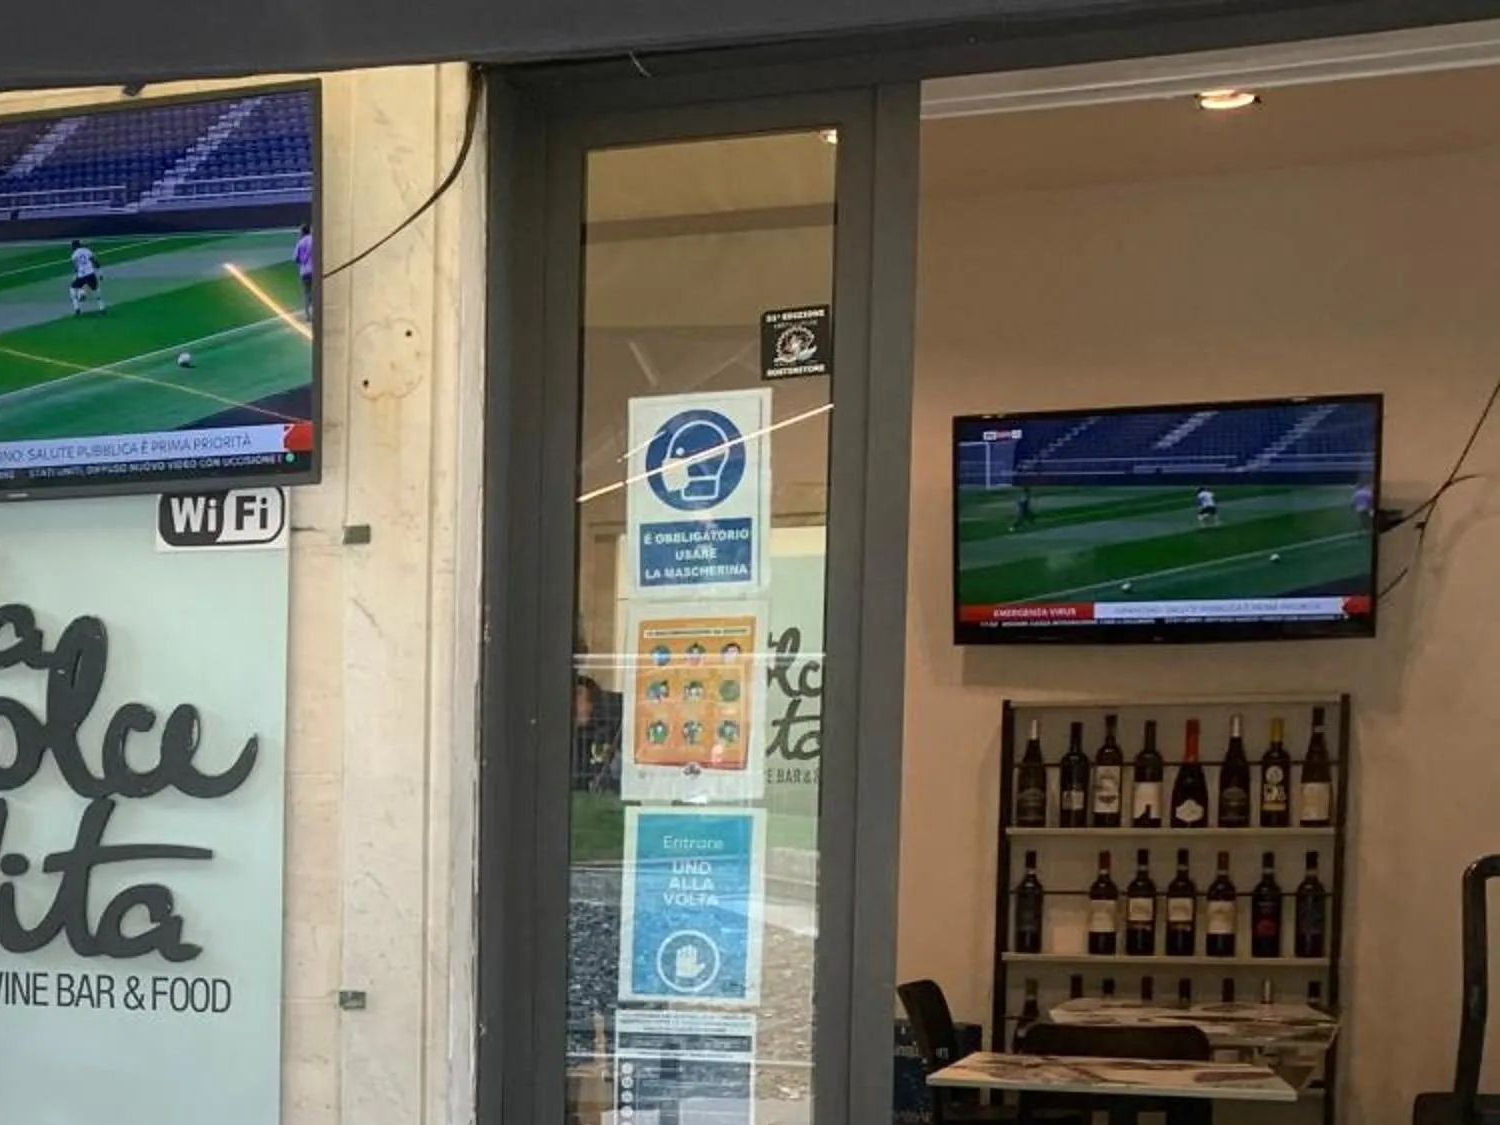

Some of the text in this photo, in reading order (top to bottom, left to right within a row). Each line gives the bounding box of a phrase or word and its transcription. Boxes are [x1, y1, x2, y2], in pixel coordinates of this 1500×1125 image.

[27, 446, 75, 460] SALUTE
[151, 438, 191, 452] PRIMA
[655, 529, 749, 545] OBBLIGATORIO
[675, 547, 717, 560] USARE
[645, 563, 749, 579] LA MASCHERINA
[663, 835, 725, 850] Entrare
[668, 876, 715, 891] ALLA
[662, 891, 721, 906] VOLTA
[57, 973, 115, 1009] BAR
[122, 979, 146, 1011] &
[151, 976, 232, 1013] FOOD
